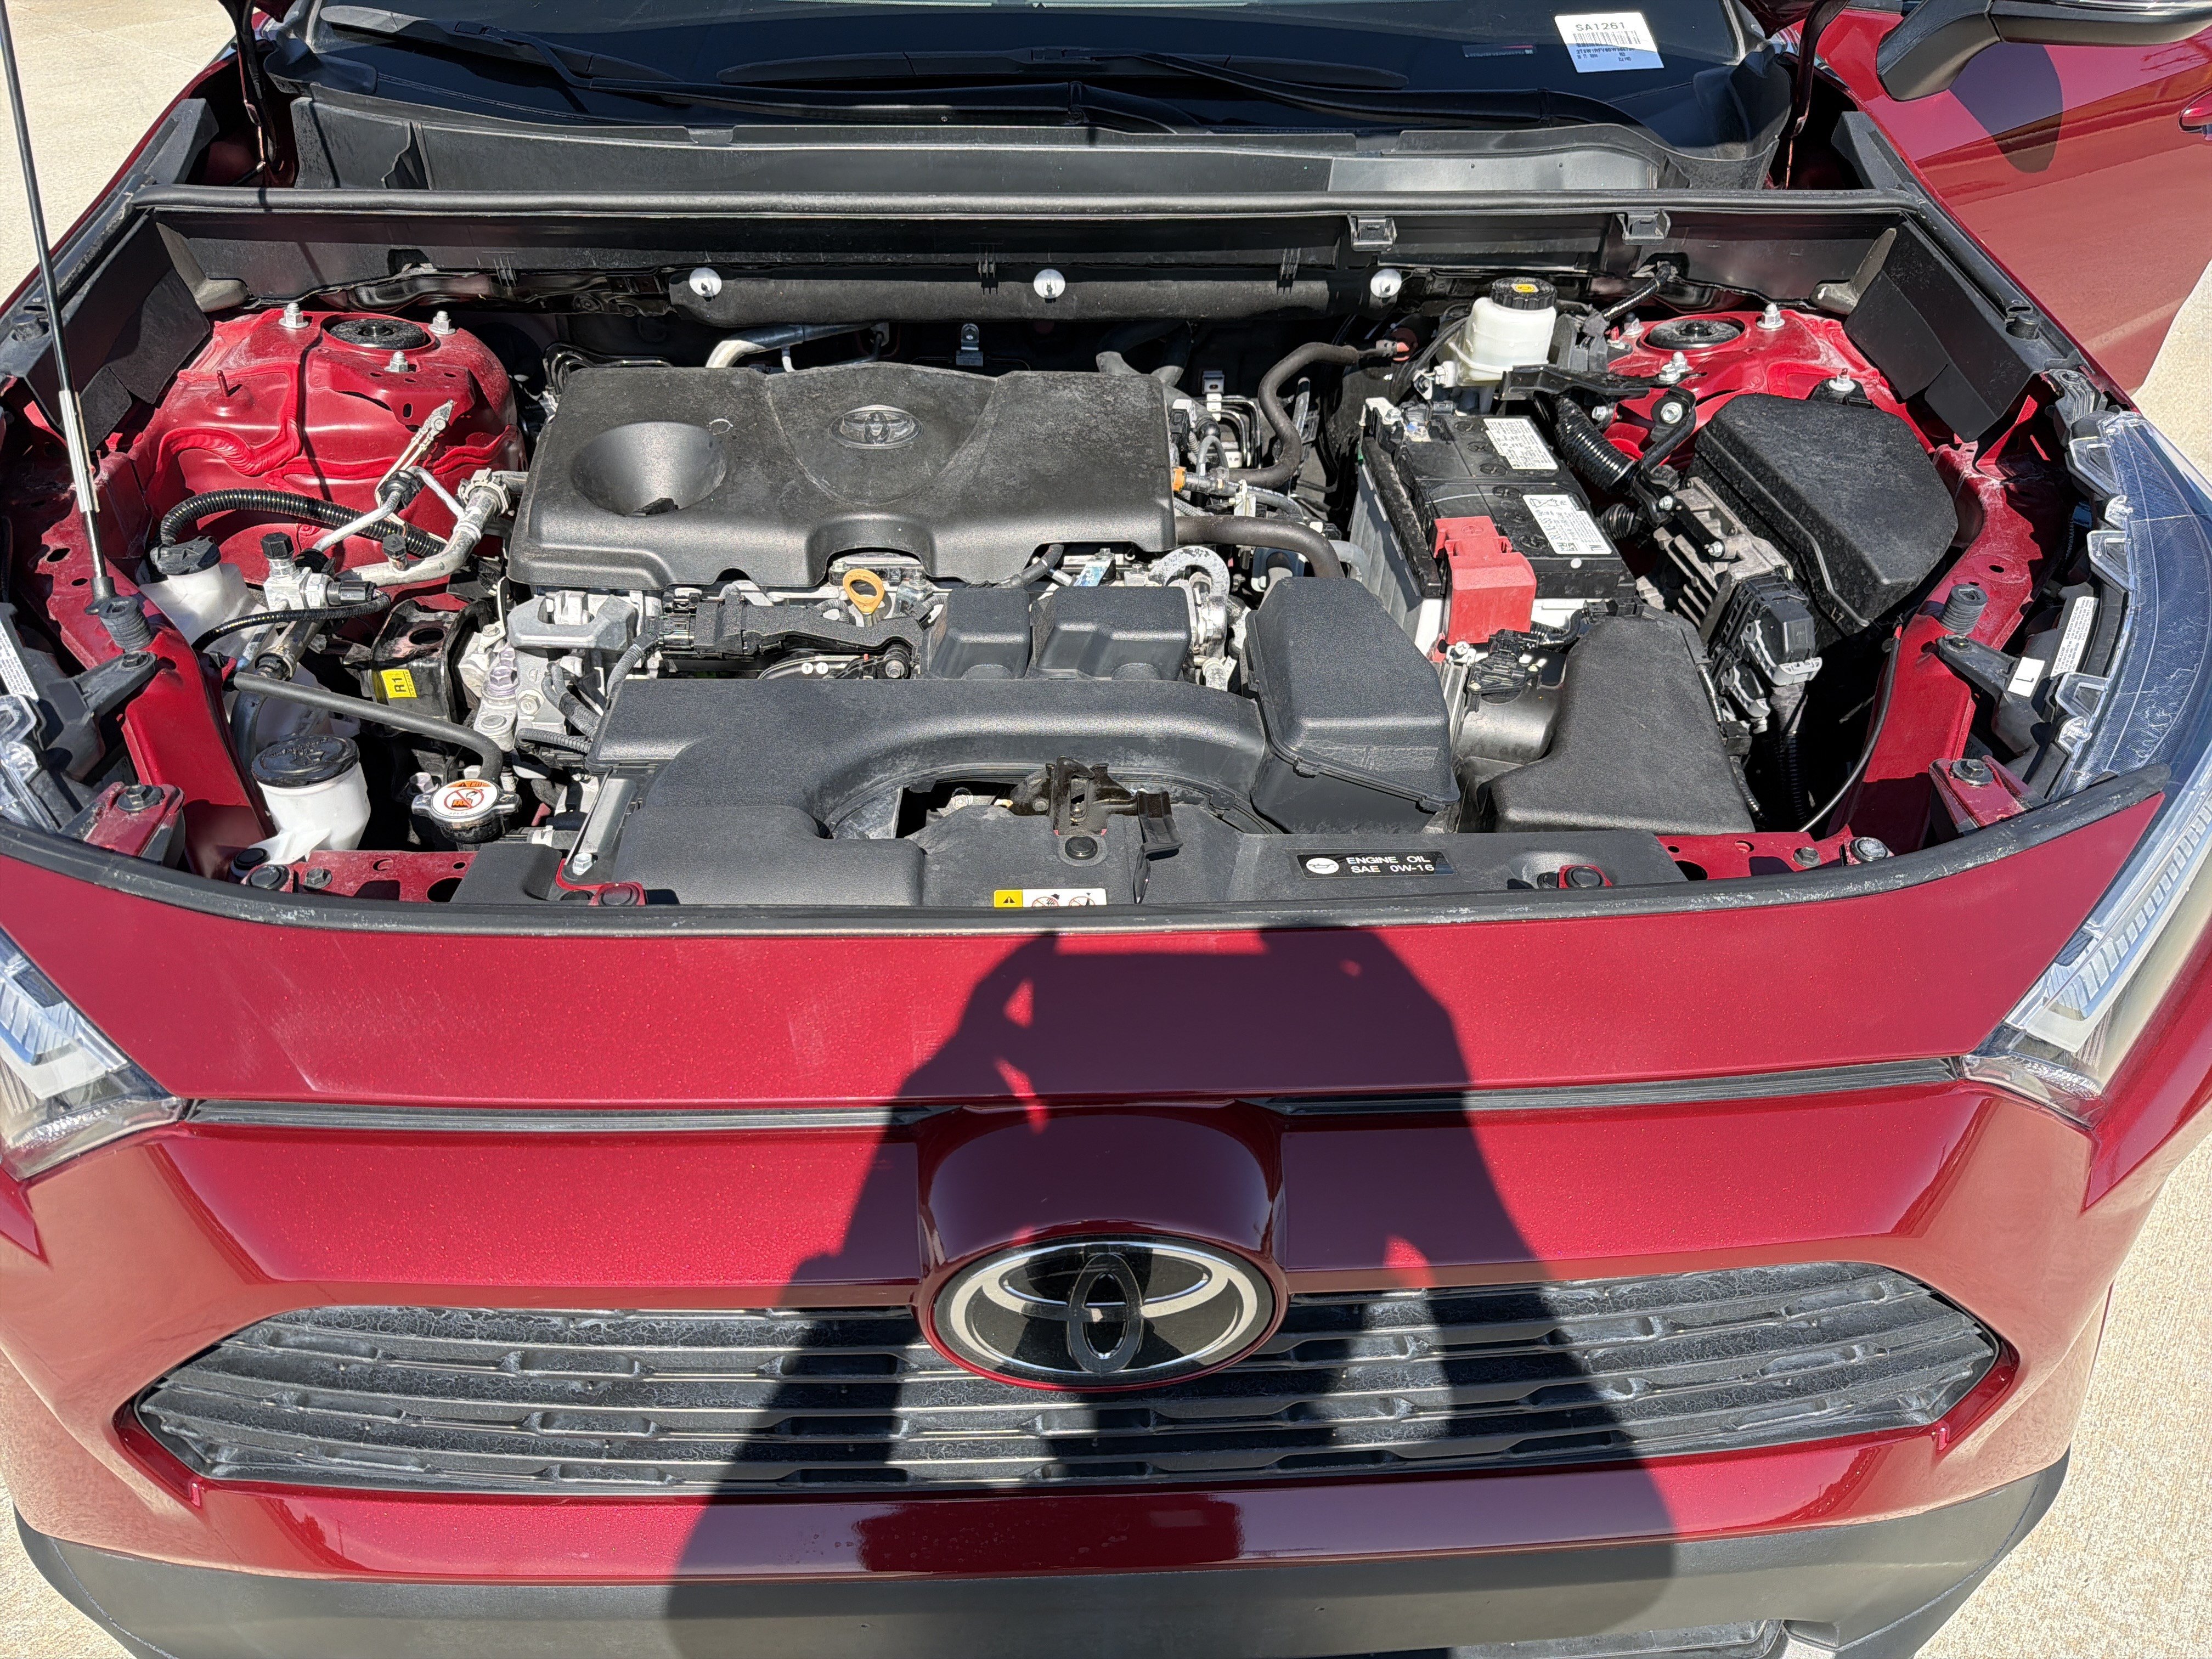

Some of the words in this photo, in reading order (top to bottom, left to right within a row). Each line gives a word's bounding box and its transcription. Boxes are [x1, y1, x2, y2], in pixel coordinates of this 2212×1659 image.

[1575, 22, 1625, 31] SA1261
[391, 678, 407, 692] R1
[1390, 864, 1435, 872] 0W-16
